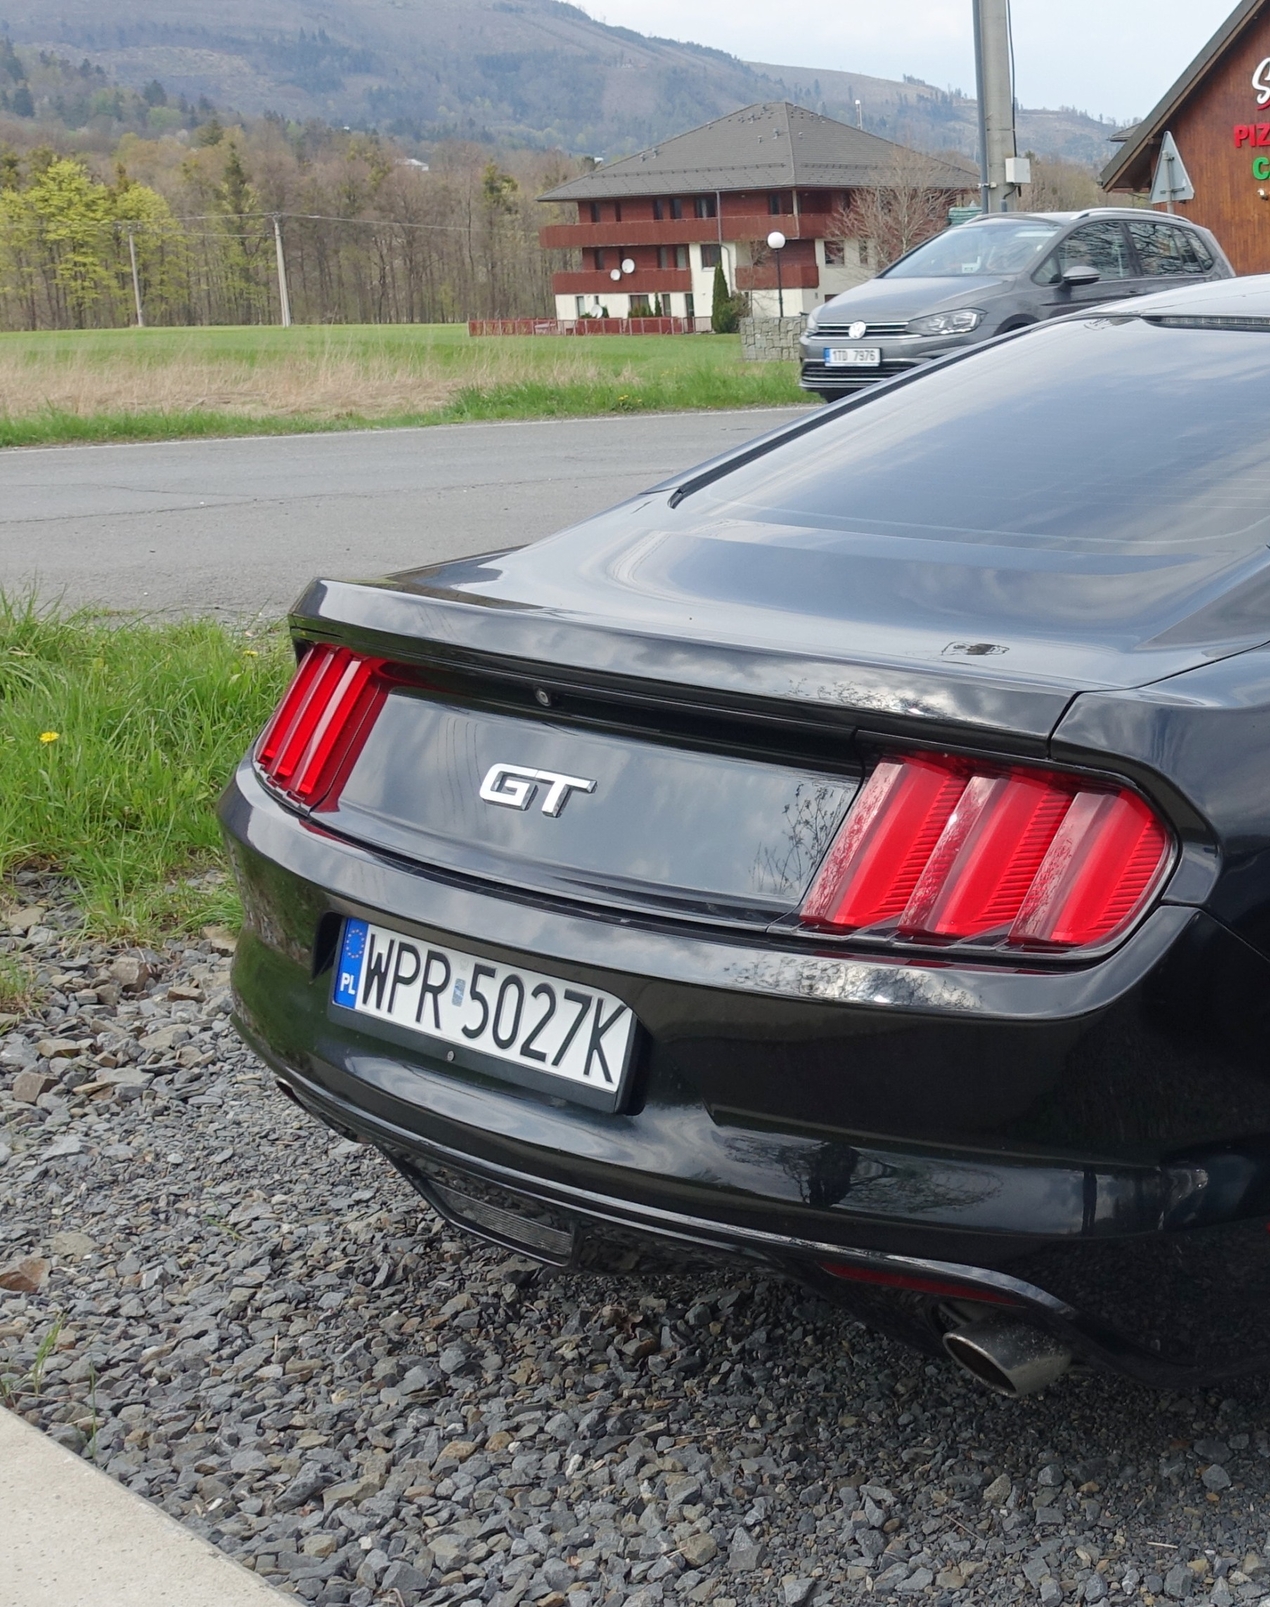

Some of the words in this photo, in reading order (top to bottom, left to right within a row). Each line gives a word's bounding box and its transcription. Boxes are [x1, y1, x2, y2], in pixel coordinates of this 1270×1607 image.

[853, 350, 876, 362] 7976
[479, 762, 598, 818] GT
[339, 972, 356, 996] PL
[361, 932, 452, 1030] WPR
[461, 962, 630, 1085] 5027K
